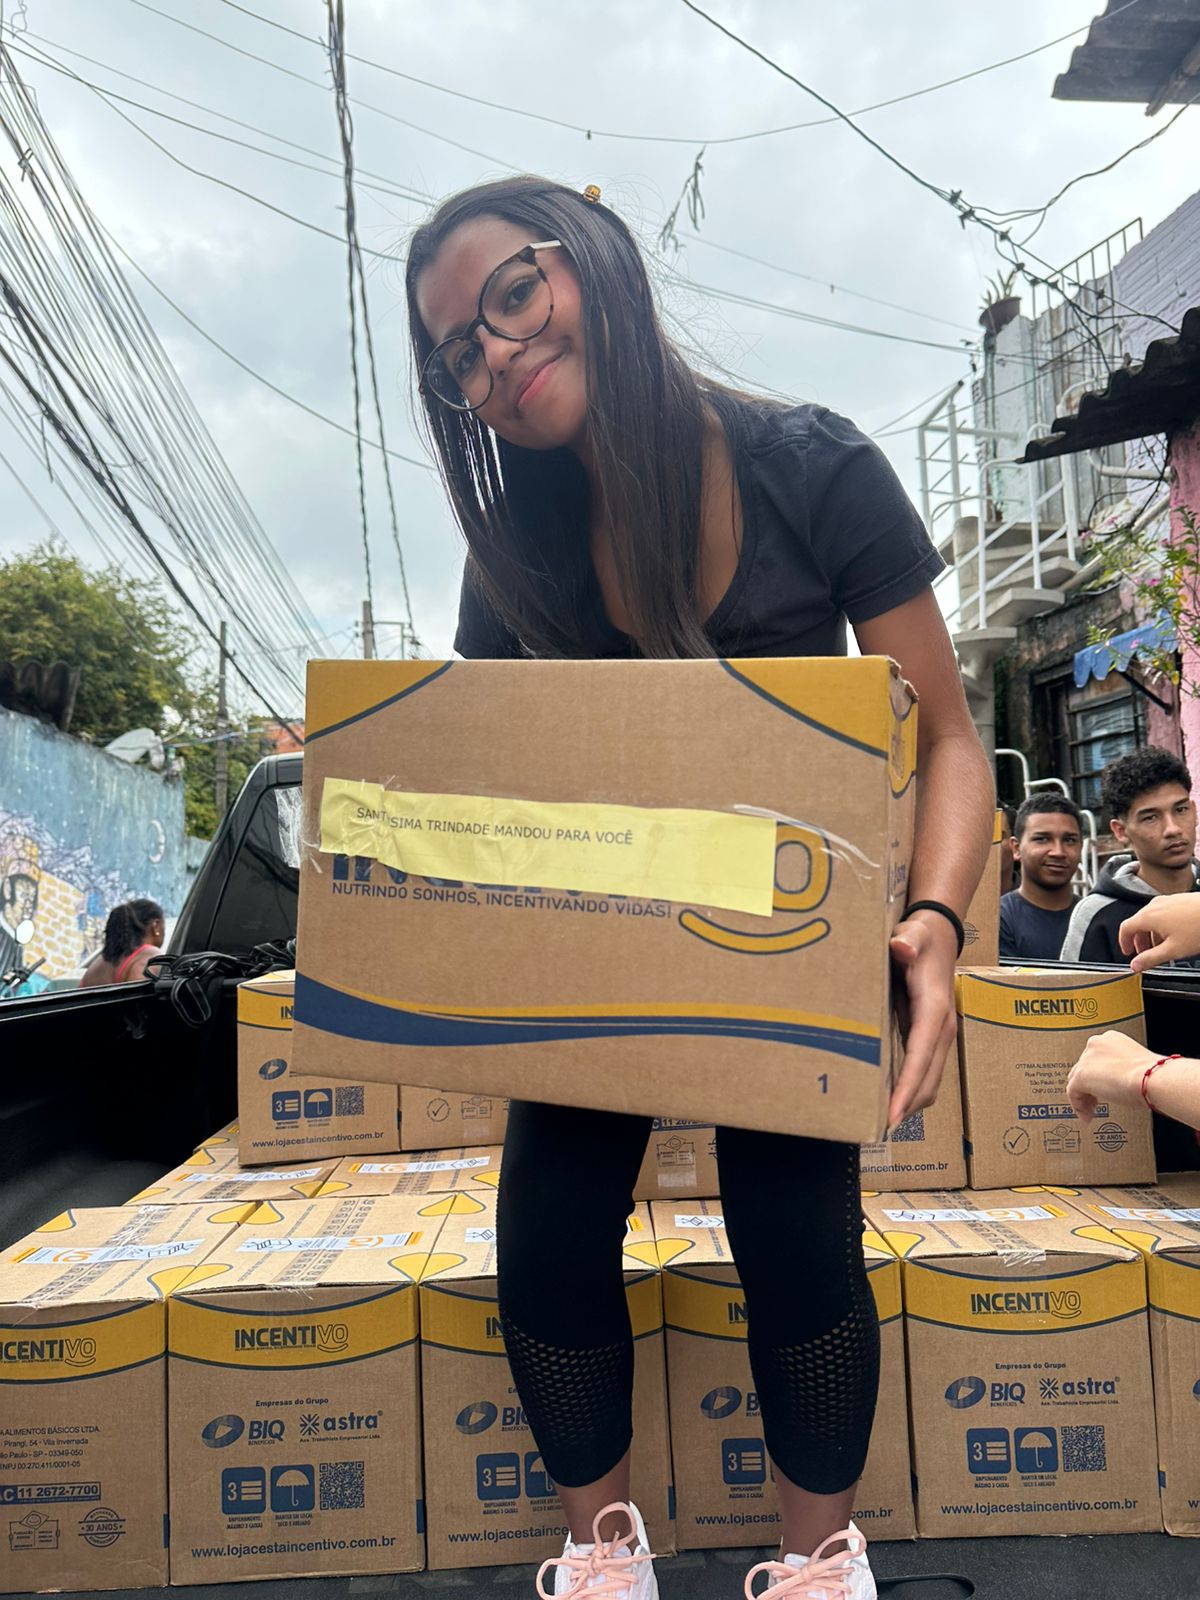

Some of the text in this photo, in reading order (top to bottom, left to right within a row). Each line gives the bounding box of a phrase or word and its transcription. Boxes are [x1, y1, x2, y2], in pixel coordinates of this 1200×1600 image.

[427, 820, 490, 836] TRINDADE
[494, 825, 552, 840] MANDOU
[556, 828, 591, 842] PARA
[595, 829, 633, 845] VOCÊ
[332, 882, 671, 918] NUTRINDO SONHOS, INCENTIVANDO VIDAS!
[1014, 998, 1098, 1014] INCENTIVO
[817, 1073, 828, 1094] 1
[1021, 1107, 1046, 1118] SAC
[252, 1131, 384, 1148] www.lojacestaincentivo.com.br
[860, 1161, 949, 1173] aincentivo.com.br
[970, 1291, 1081, 1312] INCENTIVO
[235, 1324, 348, 1348] INCENTIVO
[990, 1382, 1025, 1404] BIQ
[255, 1400, 292, 1408] Empresas
[306, 1398, 328, 1406] Grupo
[248, 1420, 285, 1441] BIQ
[973, 1442, 983, 1461] 3
[728, 1452, 737, 1471] 3
[483, 1468, 492, 1487] 3
[19, 1488, 31, 1497] 11
[37, 1485, 98, 1497] 2672-7700
[227, 1482, 237, 1501] 3
[941, 1499, 1138, 1516] www.lojacestaincentivo.com.br
[191, 1535, 396, 1558] www.lojacestaincentivo.com.br
